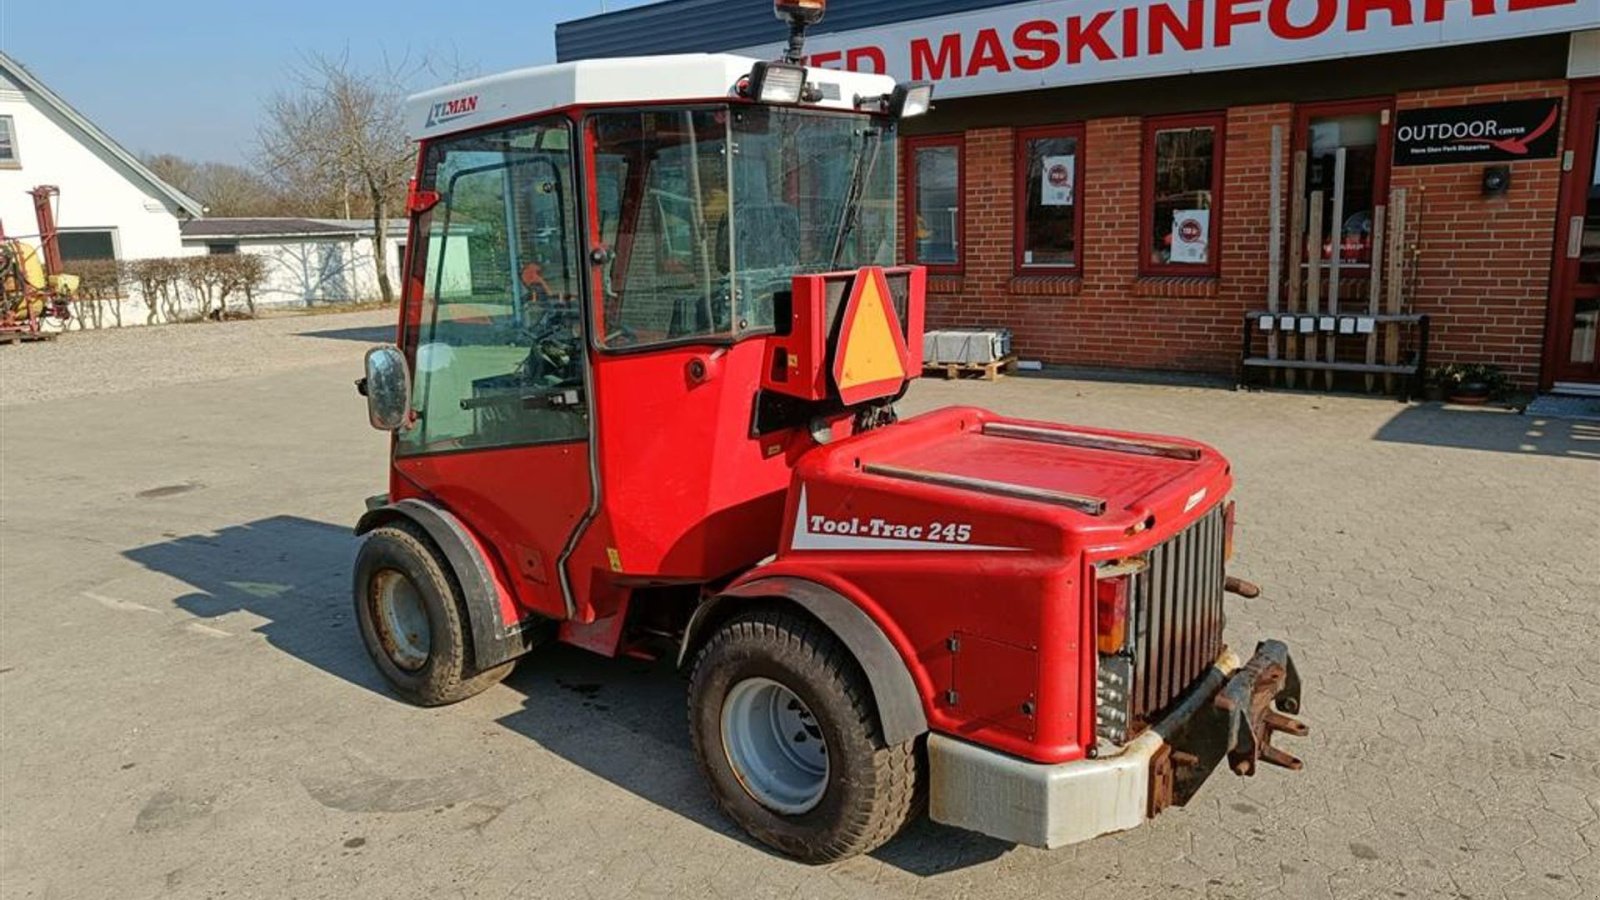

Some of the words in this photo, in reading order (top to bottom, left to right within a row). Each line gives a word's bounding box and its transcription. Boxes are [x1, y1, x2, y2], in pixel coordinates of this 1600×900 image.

[909, 0, 1576, 81] MASKINFOR
[1398, 119, 1498, 142] OUTDOOR
[811, 515, 922, 539] Tool-Trac
[927, 522, 972, 541] 245
